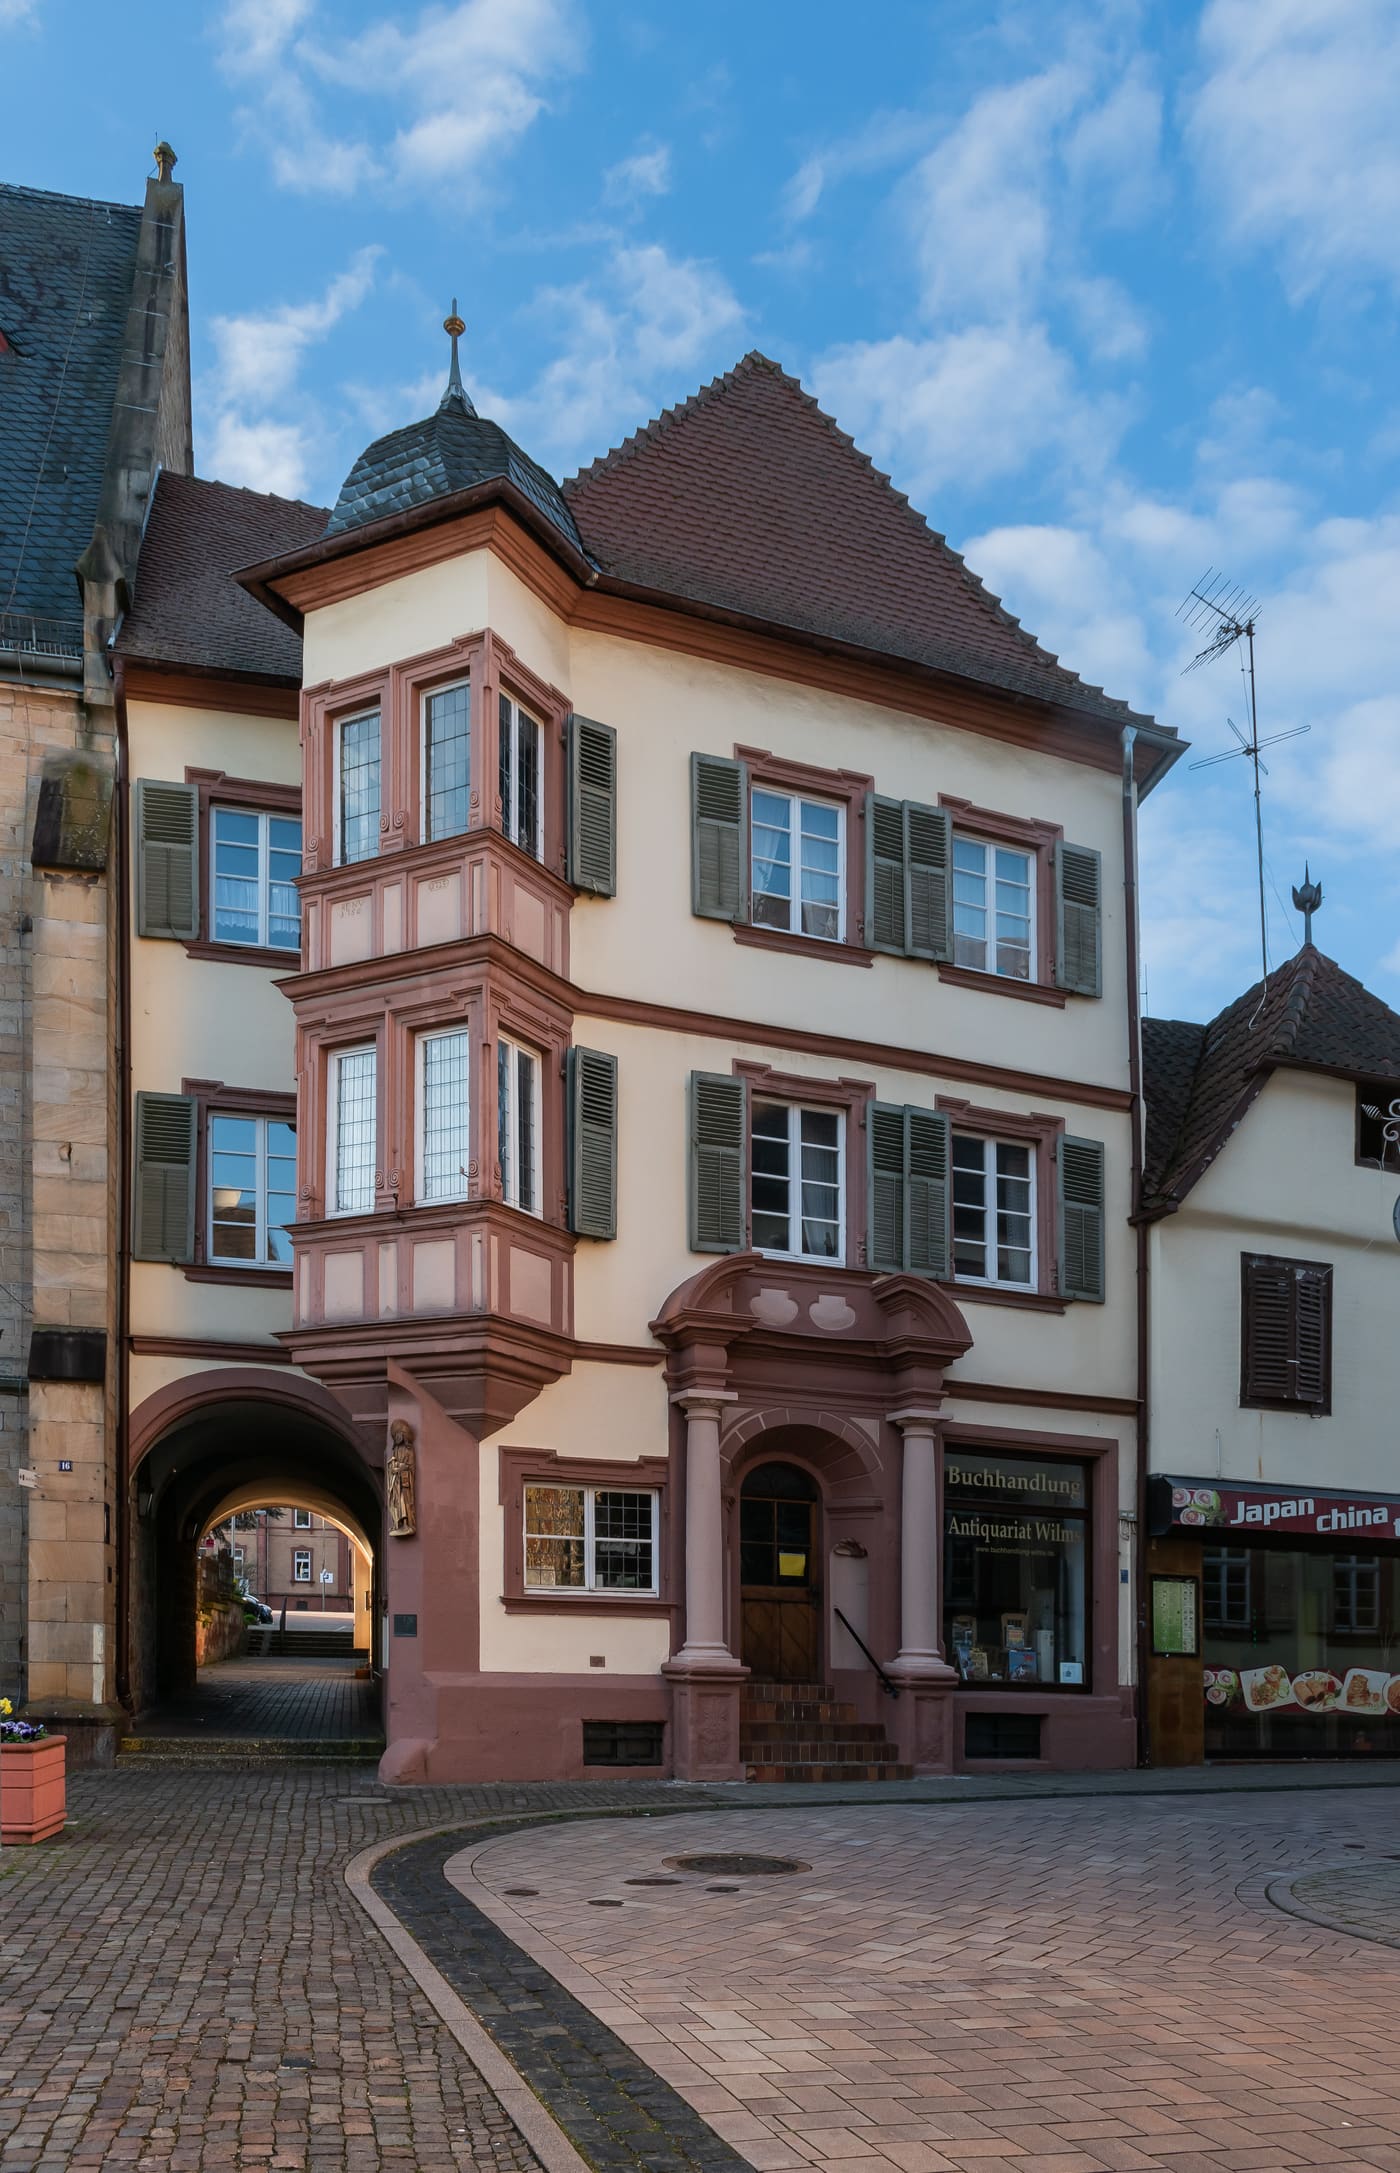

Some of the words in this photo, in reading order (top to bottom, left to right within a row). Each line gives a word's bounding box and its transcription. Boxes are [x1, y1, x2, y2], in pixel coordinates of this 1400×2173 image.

[61, 1461, 70, 1470] 16
[948, 1466, 1080, 1499] Buchhandlung
[948, 1516, 1032, 1543] Antiquariat
[1035, 1522, 1081, 1544] Wilms
[1231, 1498, 1314, 1526] Japan
[1316, 1506, 1388, 1532] china
